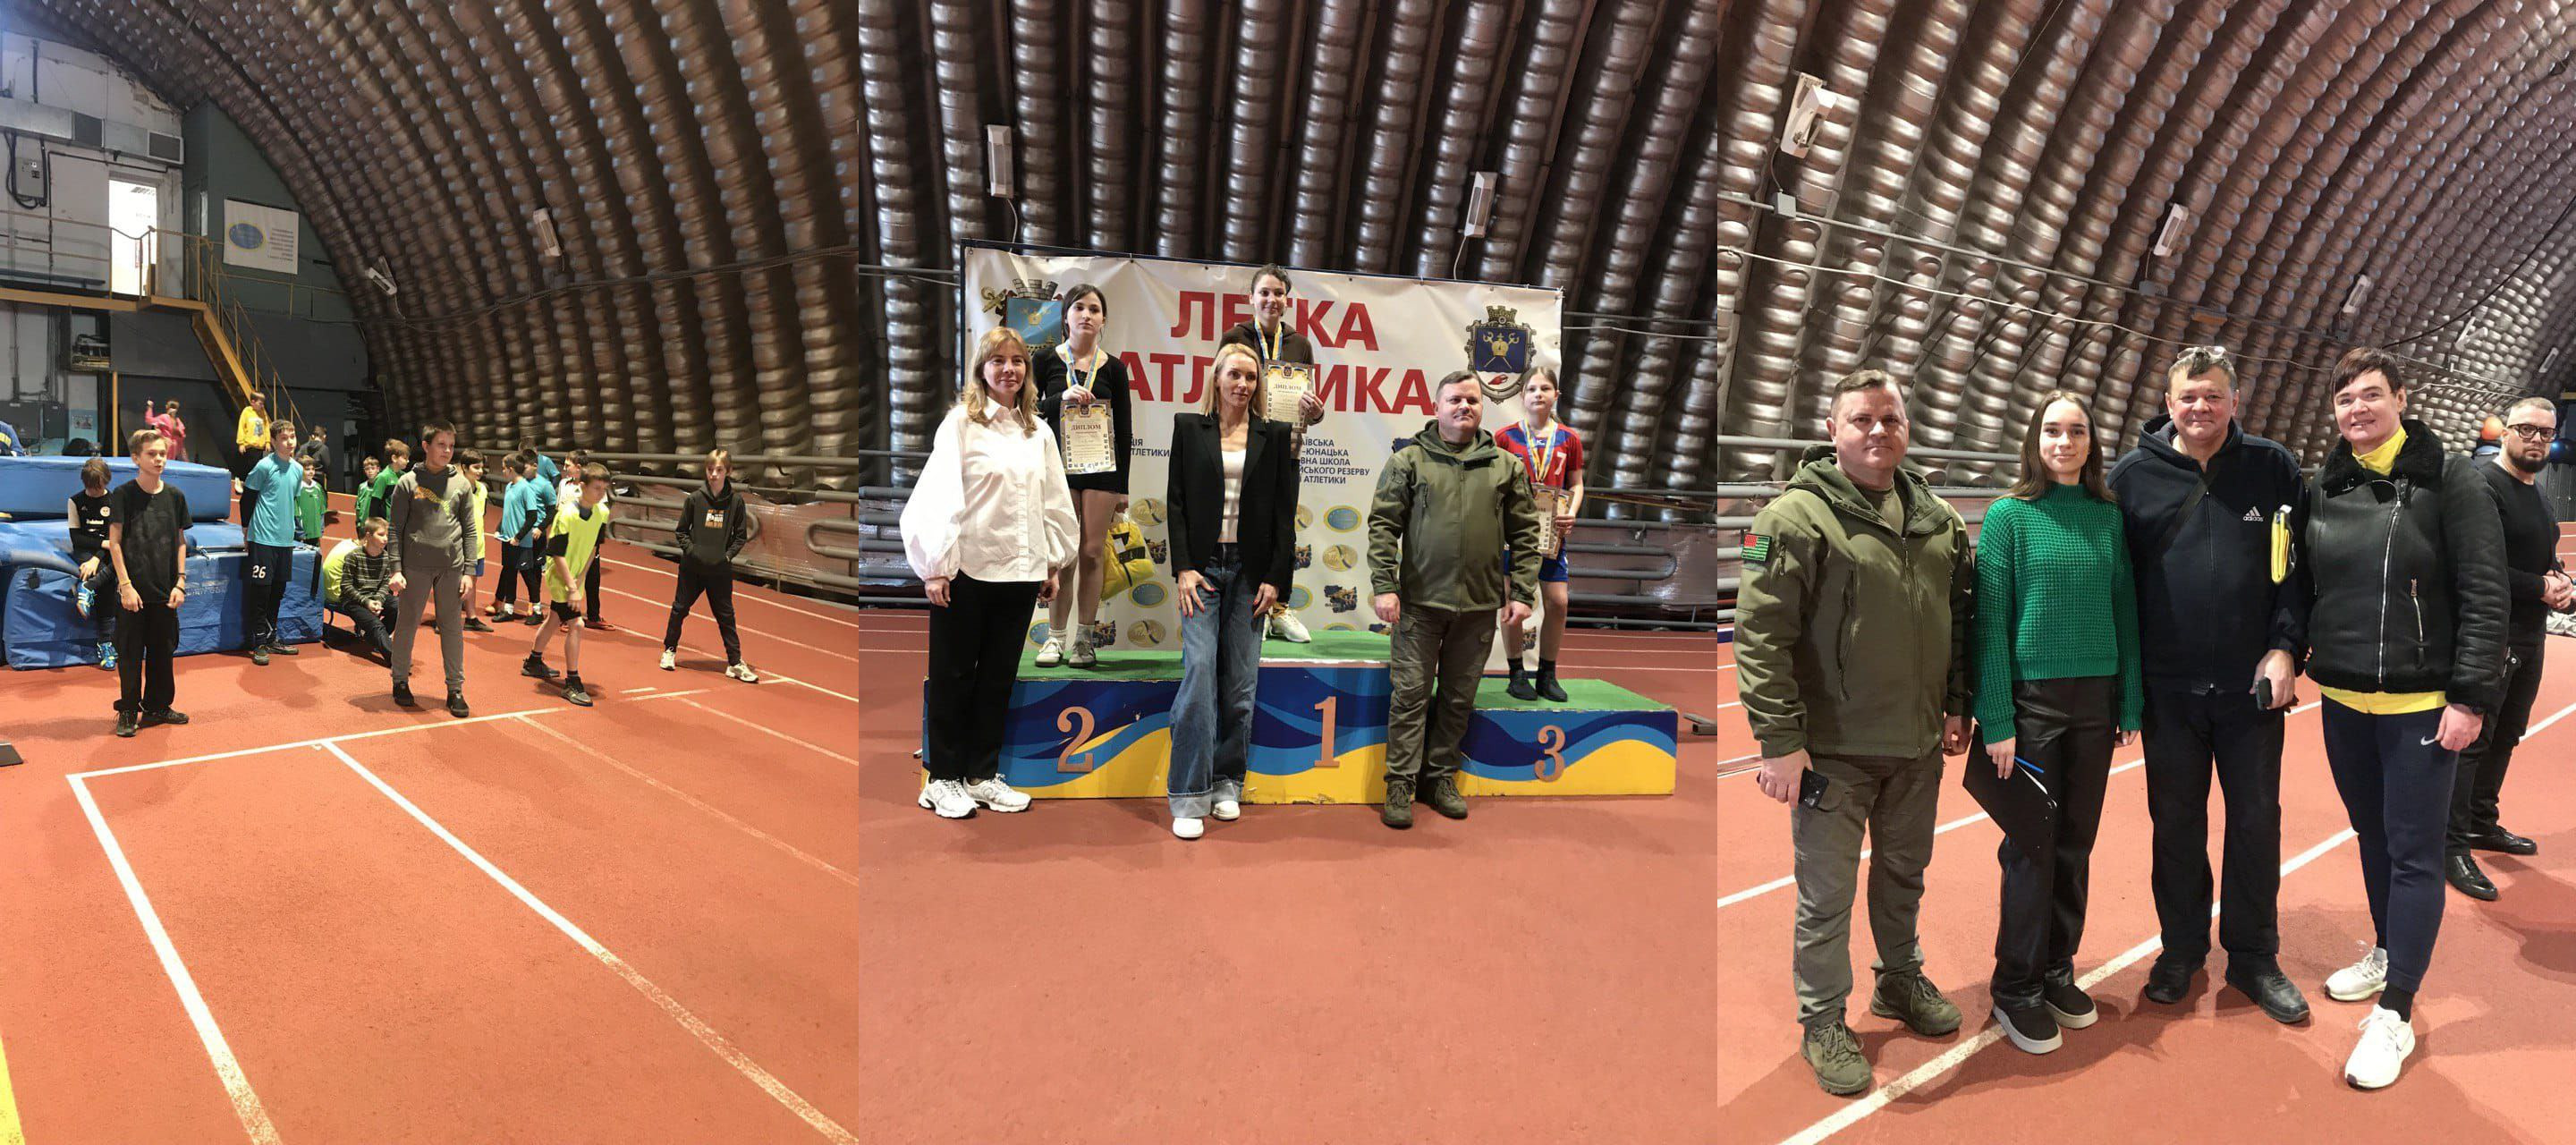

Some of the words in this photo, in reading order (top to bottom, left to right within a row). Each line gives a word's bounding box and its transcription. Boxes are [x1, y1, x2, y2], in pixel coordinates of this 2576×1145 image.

[1171, 291, 1379, 352] ЛЕКА
[1118, 351, 1435, 416] АТЛИКА
[1303, 475, 1346, 484] АТЛЕТИКИ
[1319, 457, 1351, 466] ШКОЛА
[1337, 467, 1370, 476] РЕЗЕРВУ
[1555, 451, 1567, 475] 7
[251, 564, 267, 580] 26
[1056, 706, 1095, 773] 2
[1314, 696, 1340, 767] 1
[1534, 725, 1565, 783] 3
